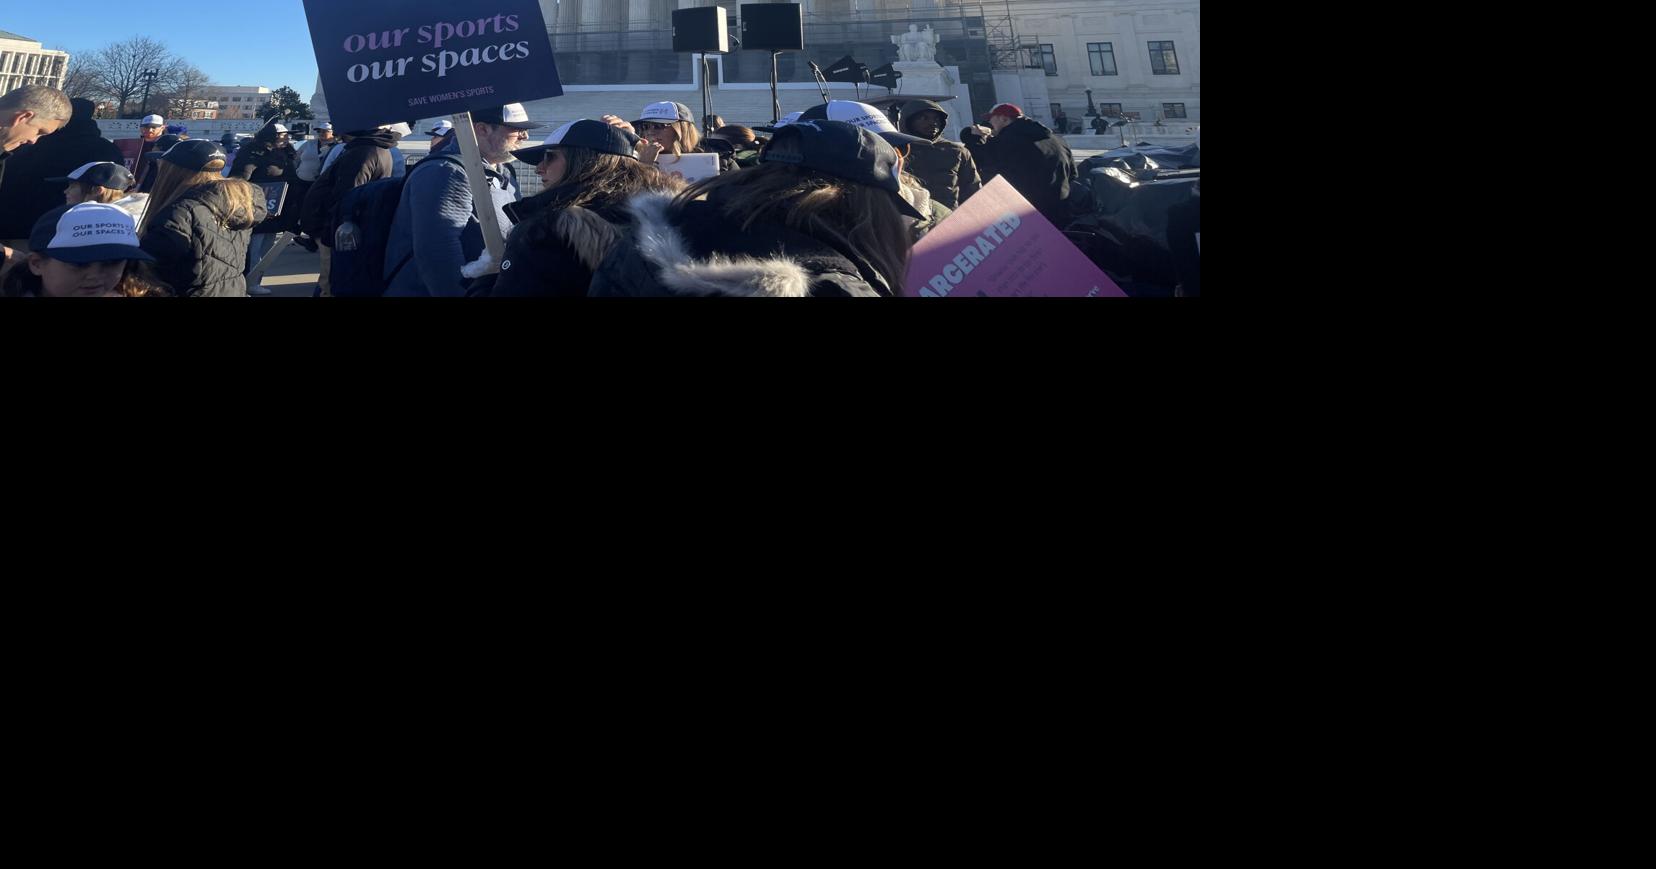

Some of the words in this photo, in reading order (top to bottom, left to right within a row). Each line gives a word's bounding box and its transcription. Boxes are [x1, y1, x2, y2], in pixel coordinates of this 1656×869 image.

[343, 27, 410, 53] our
[416, 13, 520, 49] sports
[346, 56, 414, 83] our
[421, 40, 530, 77] spaces
[408, 96, 428, 106] SAVE
[429, 90, 465, 103] WOMEN'S
[466, 86, 494, 97] SPORTS
[72, 230, 93, 238] OUR
